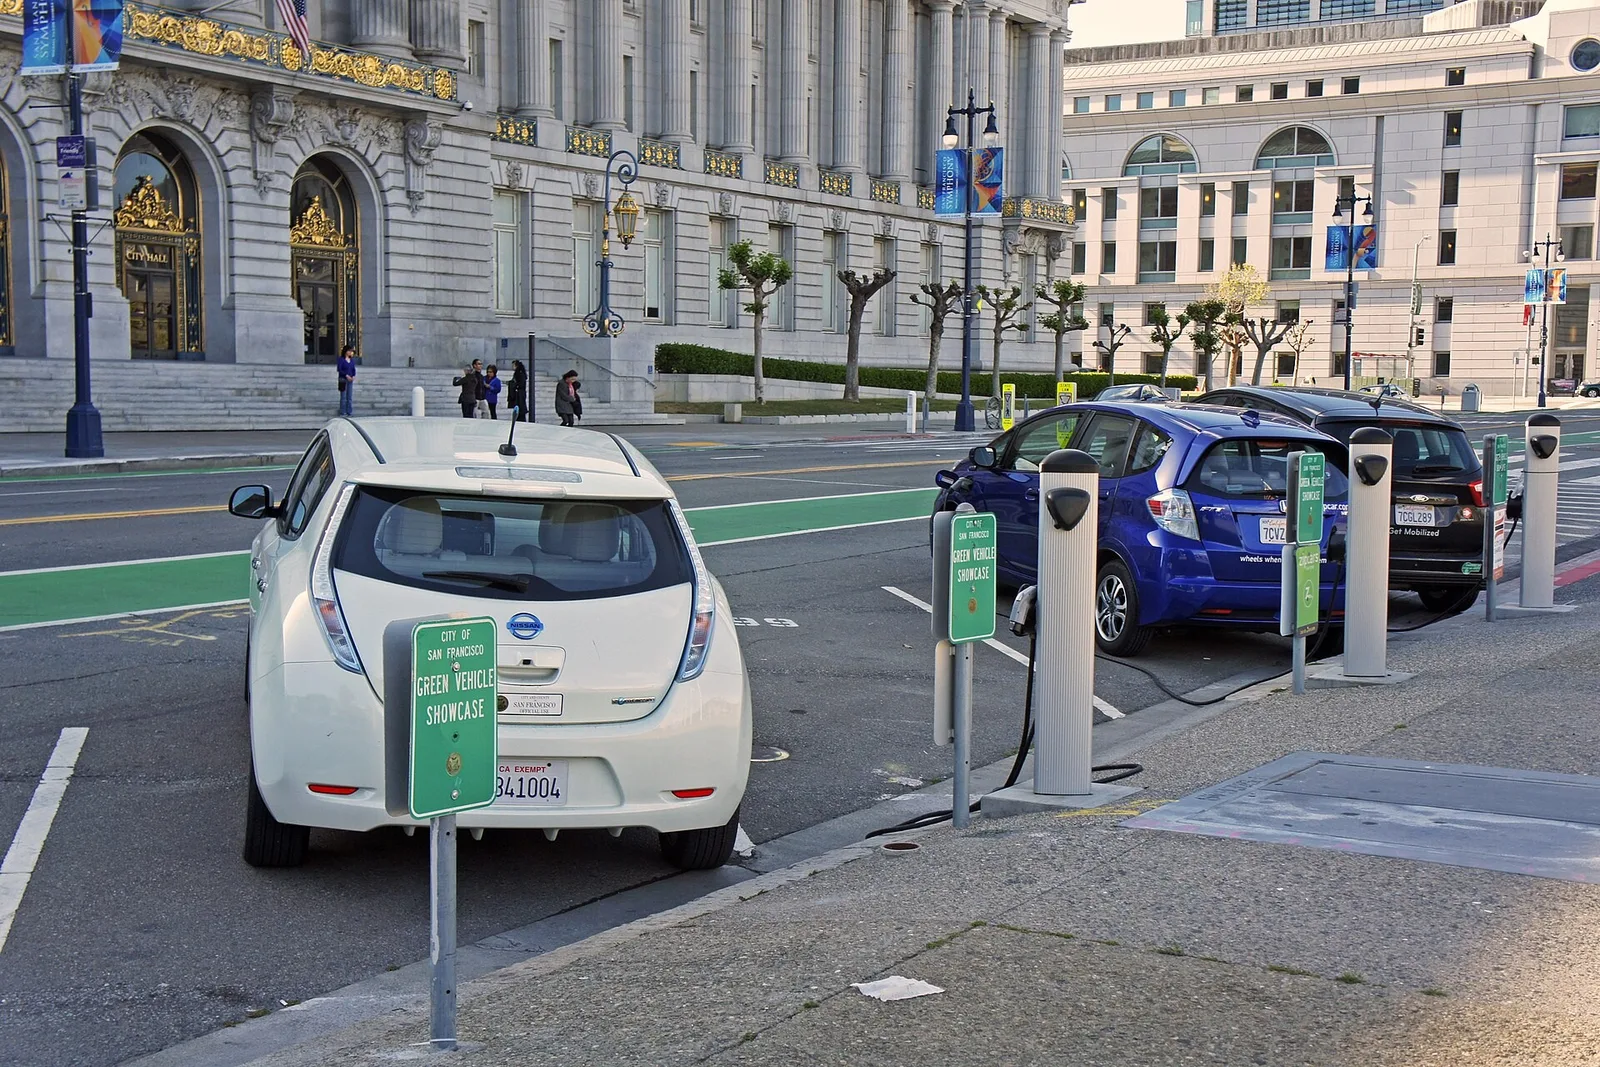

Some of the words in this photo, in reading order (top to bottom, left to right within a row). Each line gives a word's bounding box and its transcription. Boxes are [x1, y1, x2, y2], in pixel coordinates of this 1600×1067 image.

[946, 156, 954, 210] SYMPHONY
[126, 252, 145, 261] CITY
[147, 253, 168, 263] HALL
[1302, 490, 1321, 501] SHOWCASE
[1398, 511, 1433, 524] 7CGL289
[958, 532, 967, 541] SAN
[968, 530, 990, 540] FRANCISCO
[1263, 527, 1286, 541] 7CVZ
[1390, 527, 1403, 535] Get
[1404, 528, 1440, 537] Mobilized
[953, 549, 971, 563] GREEN
[972, 547, 995, 561] VEHICLE
[1240, 554, 1263, 563] wheels
[1264, 555, 1283, 564] when
[957, 566, 990, 582] SHOWCASE
[441, 630, 457, 642] CITY
[461, 629, 471, 641] OF
[427, 649, 442, 661] SAN
[446, 644, 484, 659] FRANCISCO
[417, 674, 449, 697] GREEN
[455, 668, 494, 691] VEHICLE
[426, 698, 485, 726] SHOWCASE
